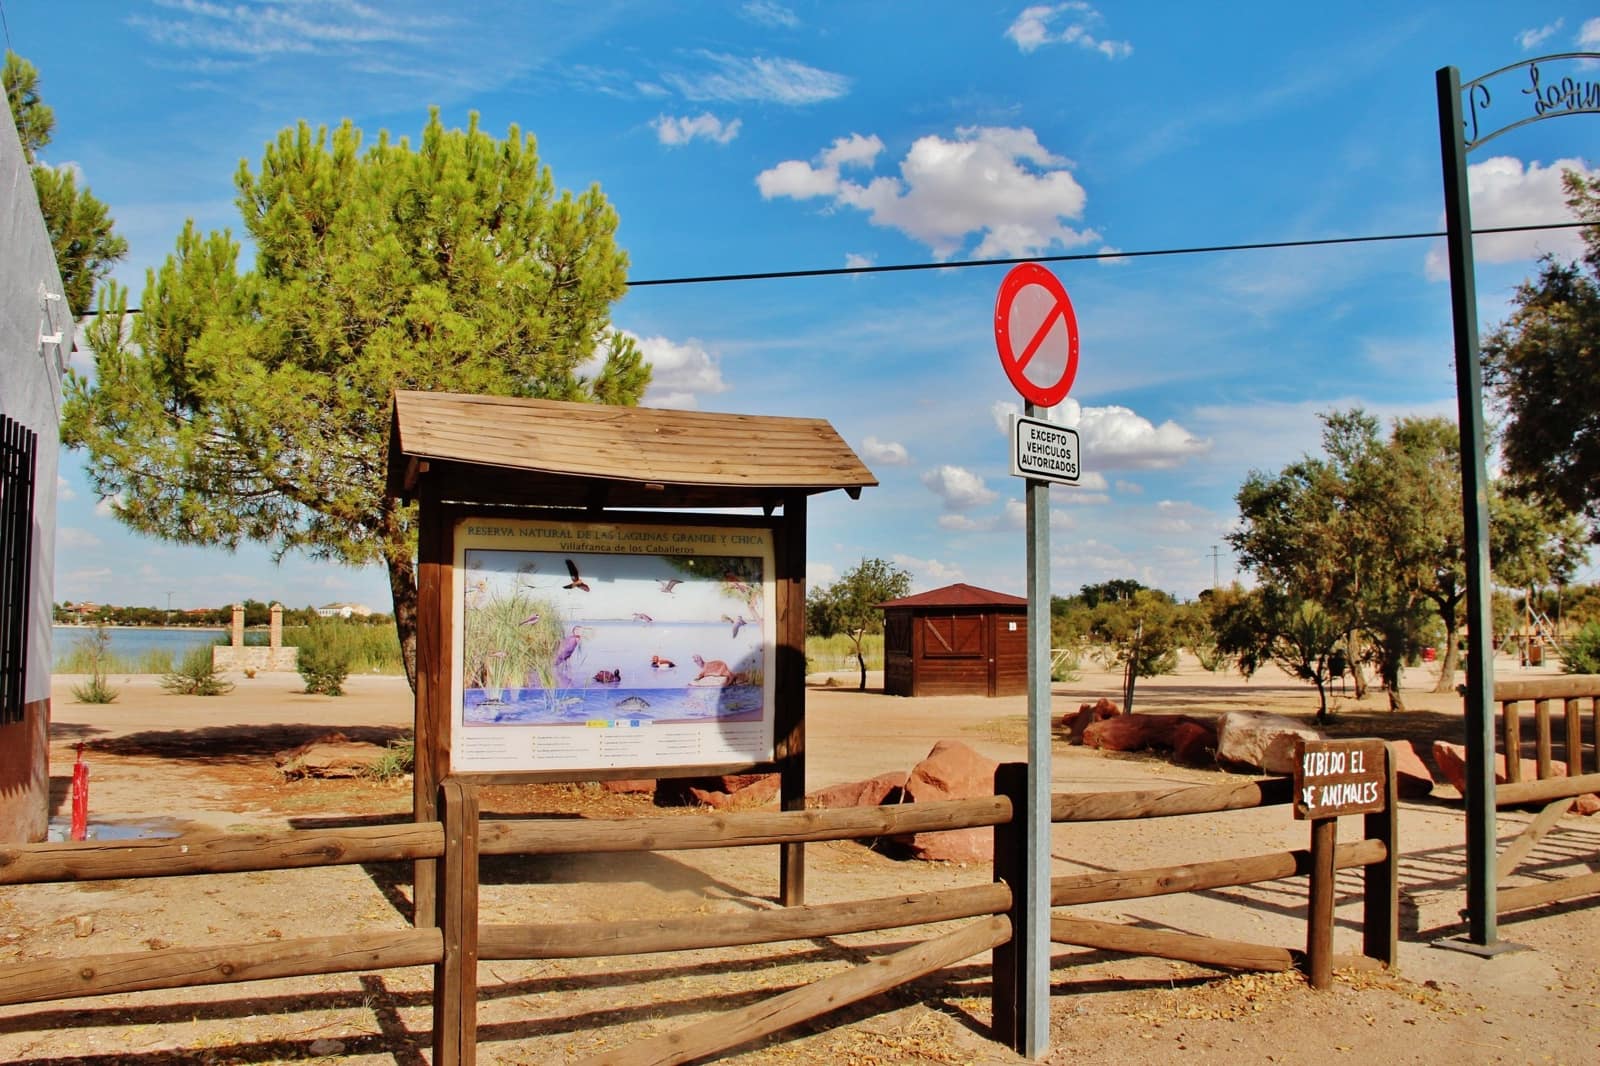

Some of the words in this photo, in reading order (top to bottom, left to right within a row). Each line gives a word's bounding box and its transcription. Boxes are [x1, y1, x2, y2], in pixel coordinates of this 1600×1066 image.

[1030, 428, 1067, 446] EXCEPTO
[1026, 440, 1071, 460] VEHICULOS
[1021, 453, 1077, 474] AUTORIZADOS
[467, 526, 515, 537] RESERVA
[519, 527, 573, 539] NATURAL
[576, 530, 592, 540] DE
[595, 530, 615, 541] LAS
[617, 531, 669, 543] LAGUNAS
[671, 532, 717, 544] GRANDE
[720, 534, 728, 545] Y
[730, 535, 764, 545] CHICA
[560, 542, 611, 552] Villafranca
[614, 544, 626, 553] de
[629, 543, 642, 553] los
[646, 544, 695, 554] Caballeros
[1350, 750, 1367, 774] EL
[1320, 781, 1379, 809] ANIMALES
